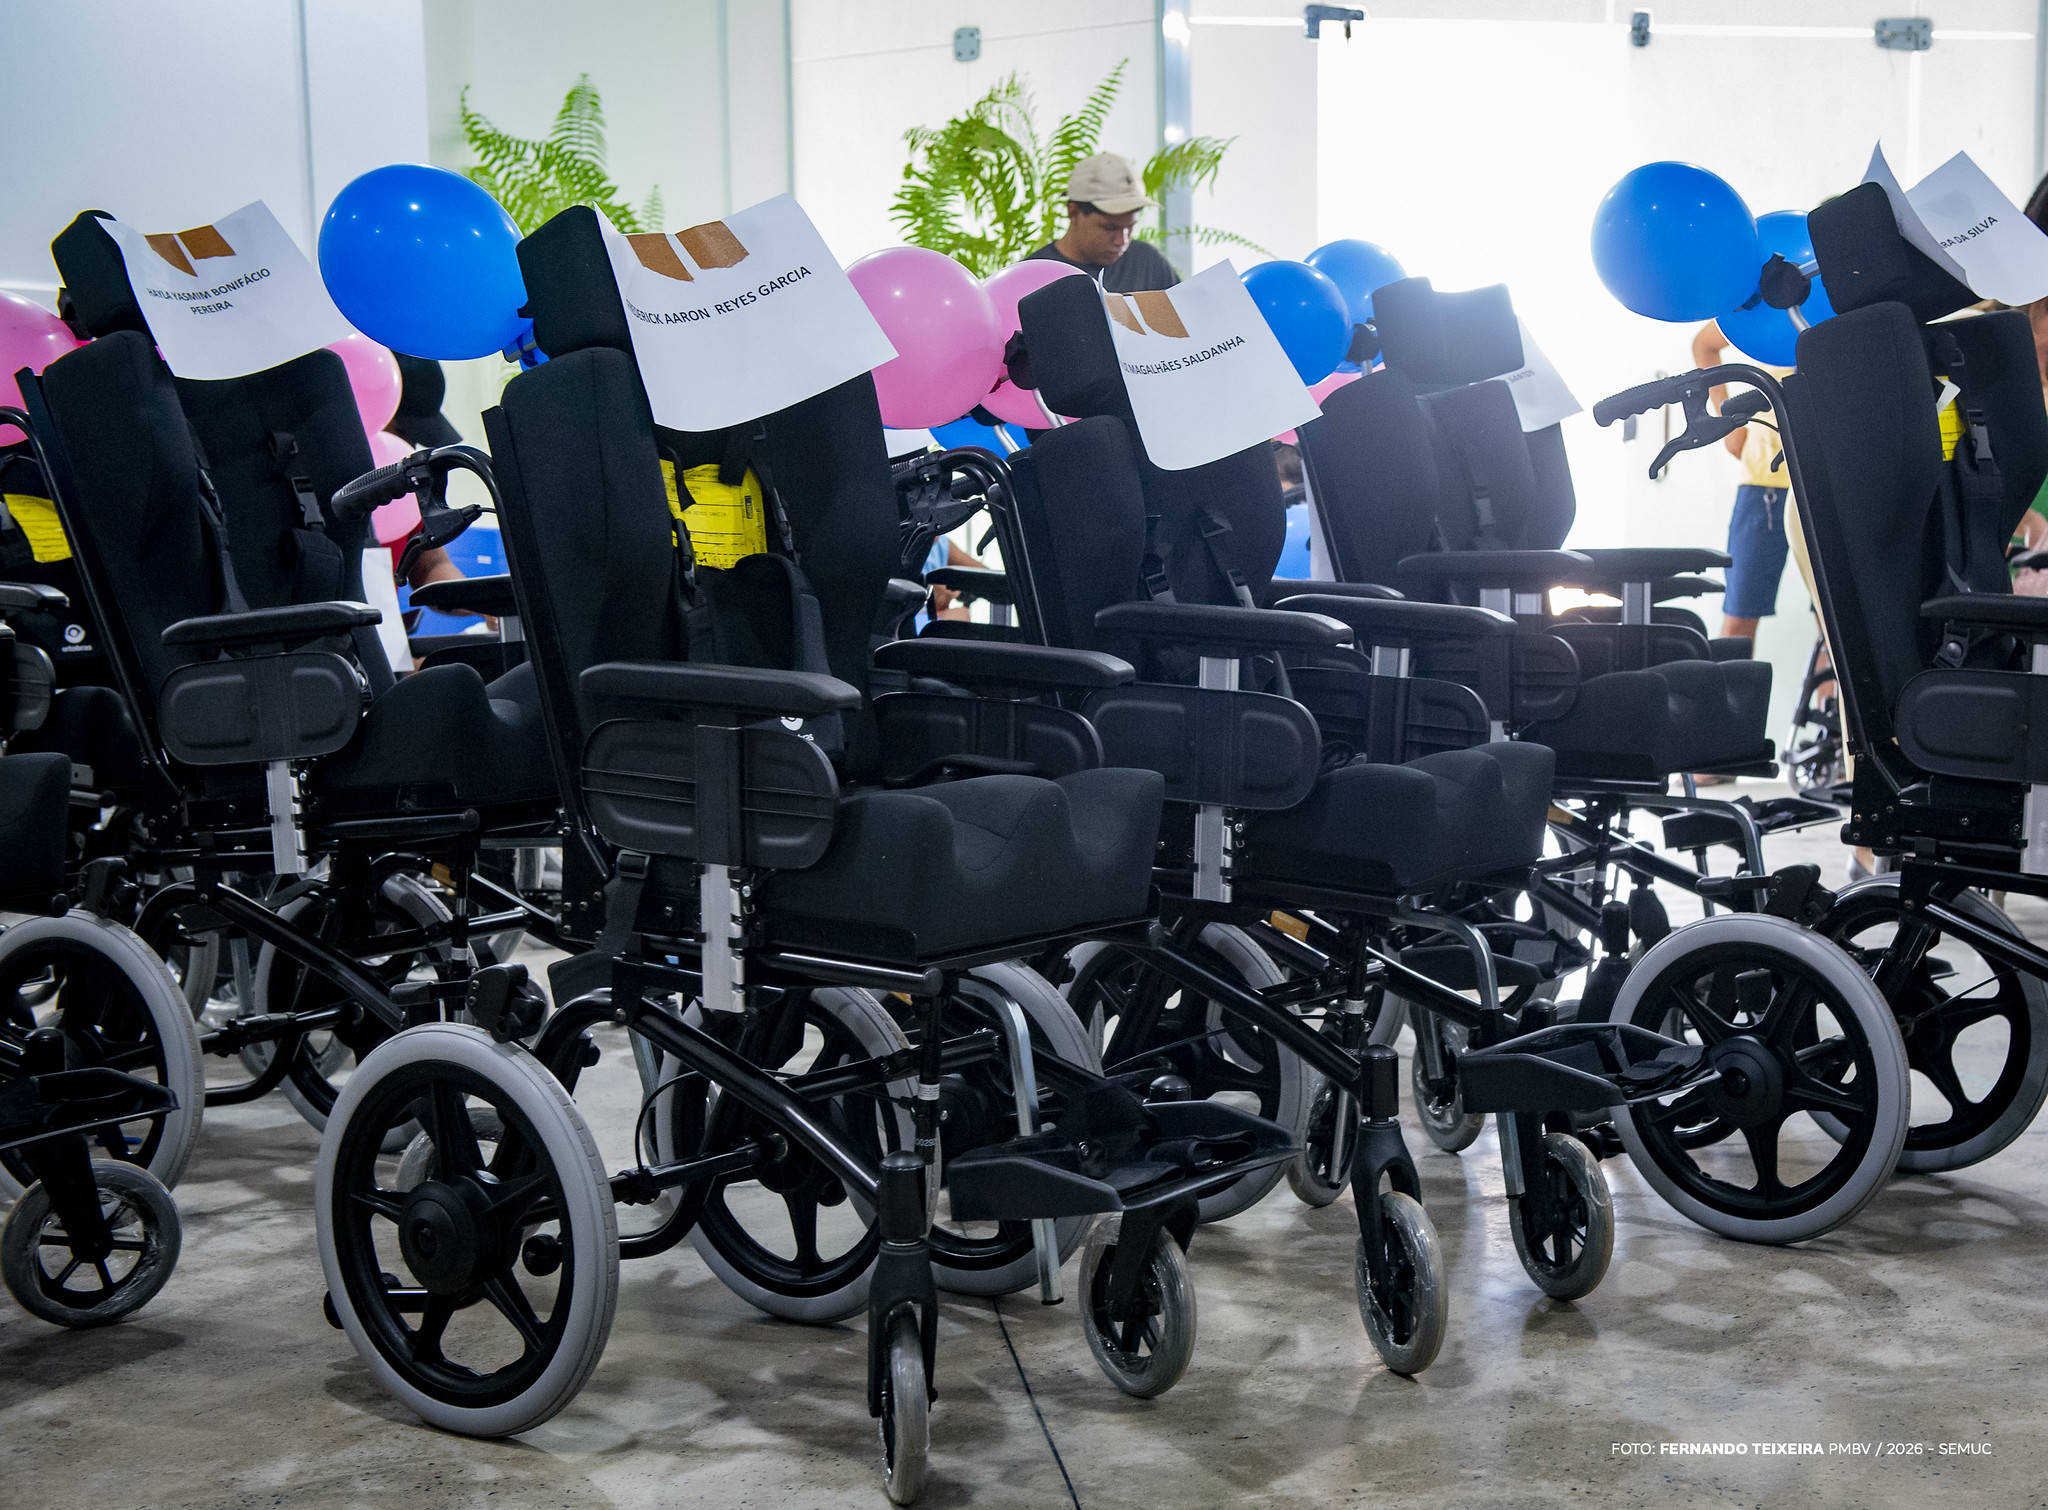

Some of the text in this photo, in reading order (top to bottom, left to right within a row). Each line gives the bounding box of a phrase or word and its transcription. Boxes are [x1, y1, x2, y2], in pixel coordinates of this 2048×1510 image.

[1954, 234, 1971, 244] DA
[1967, 215, 1999, 239] SILVA
[171, 290, 210, 301] YASMIM
[210, 267, 271, 297] BONIFÁCIO
[665, 307, 711, 325] AARON
[714, 290, 758, 315] REYES
[758, 265, 812, 297] GARCIA
[190, 300, 234, 316] PEREIRA
[1128, 360, 1182, 375] MAGALHÃES
[1182, 334, 1246, 367] SALDANHA
[1508, 369, 1535, 383] SANTOS
